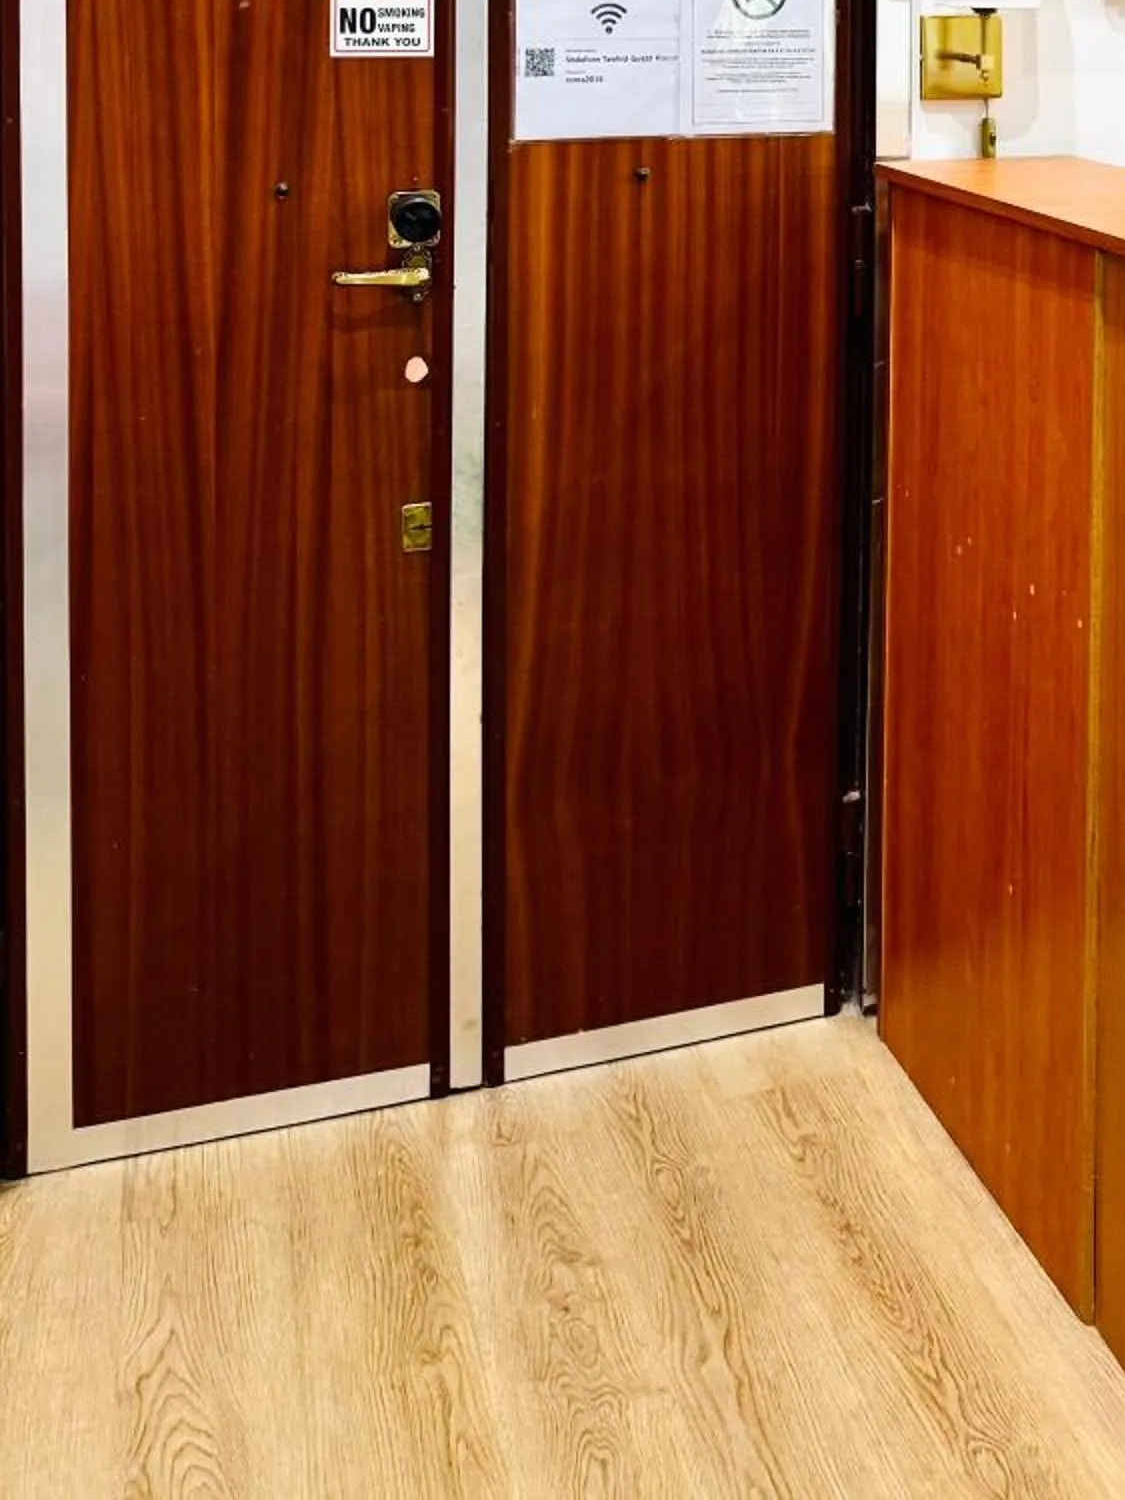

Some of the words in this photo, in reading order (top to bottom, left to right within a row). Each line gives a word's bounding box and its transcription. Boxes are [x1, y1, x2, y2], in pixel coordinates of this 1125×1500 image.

[339, 7, 377, 35] NO
[377, 7, 426, 19] SMOKING
[377, 23, 416, 34] VAPING
[343, 37, 390, 47] THANK
[394, 37, 421, 47] YOU
